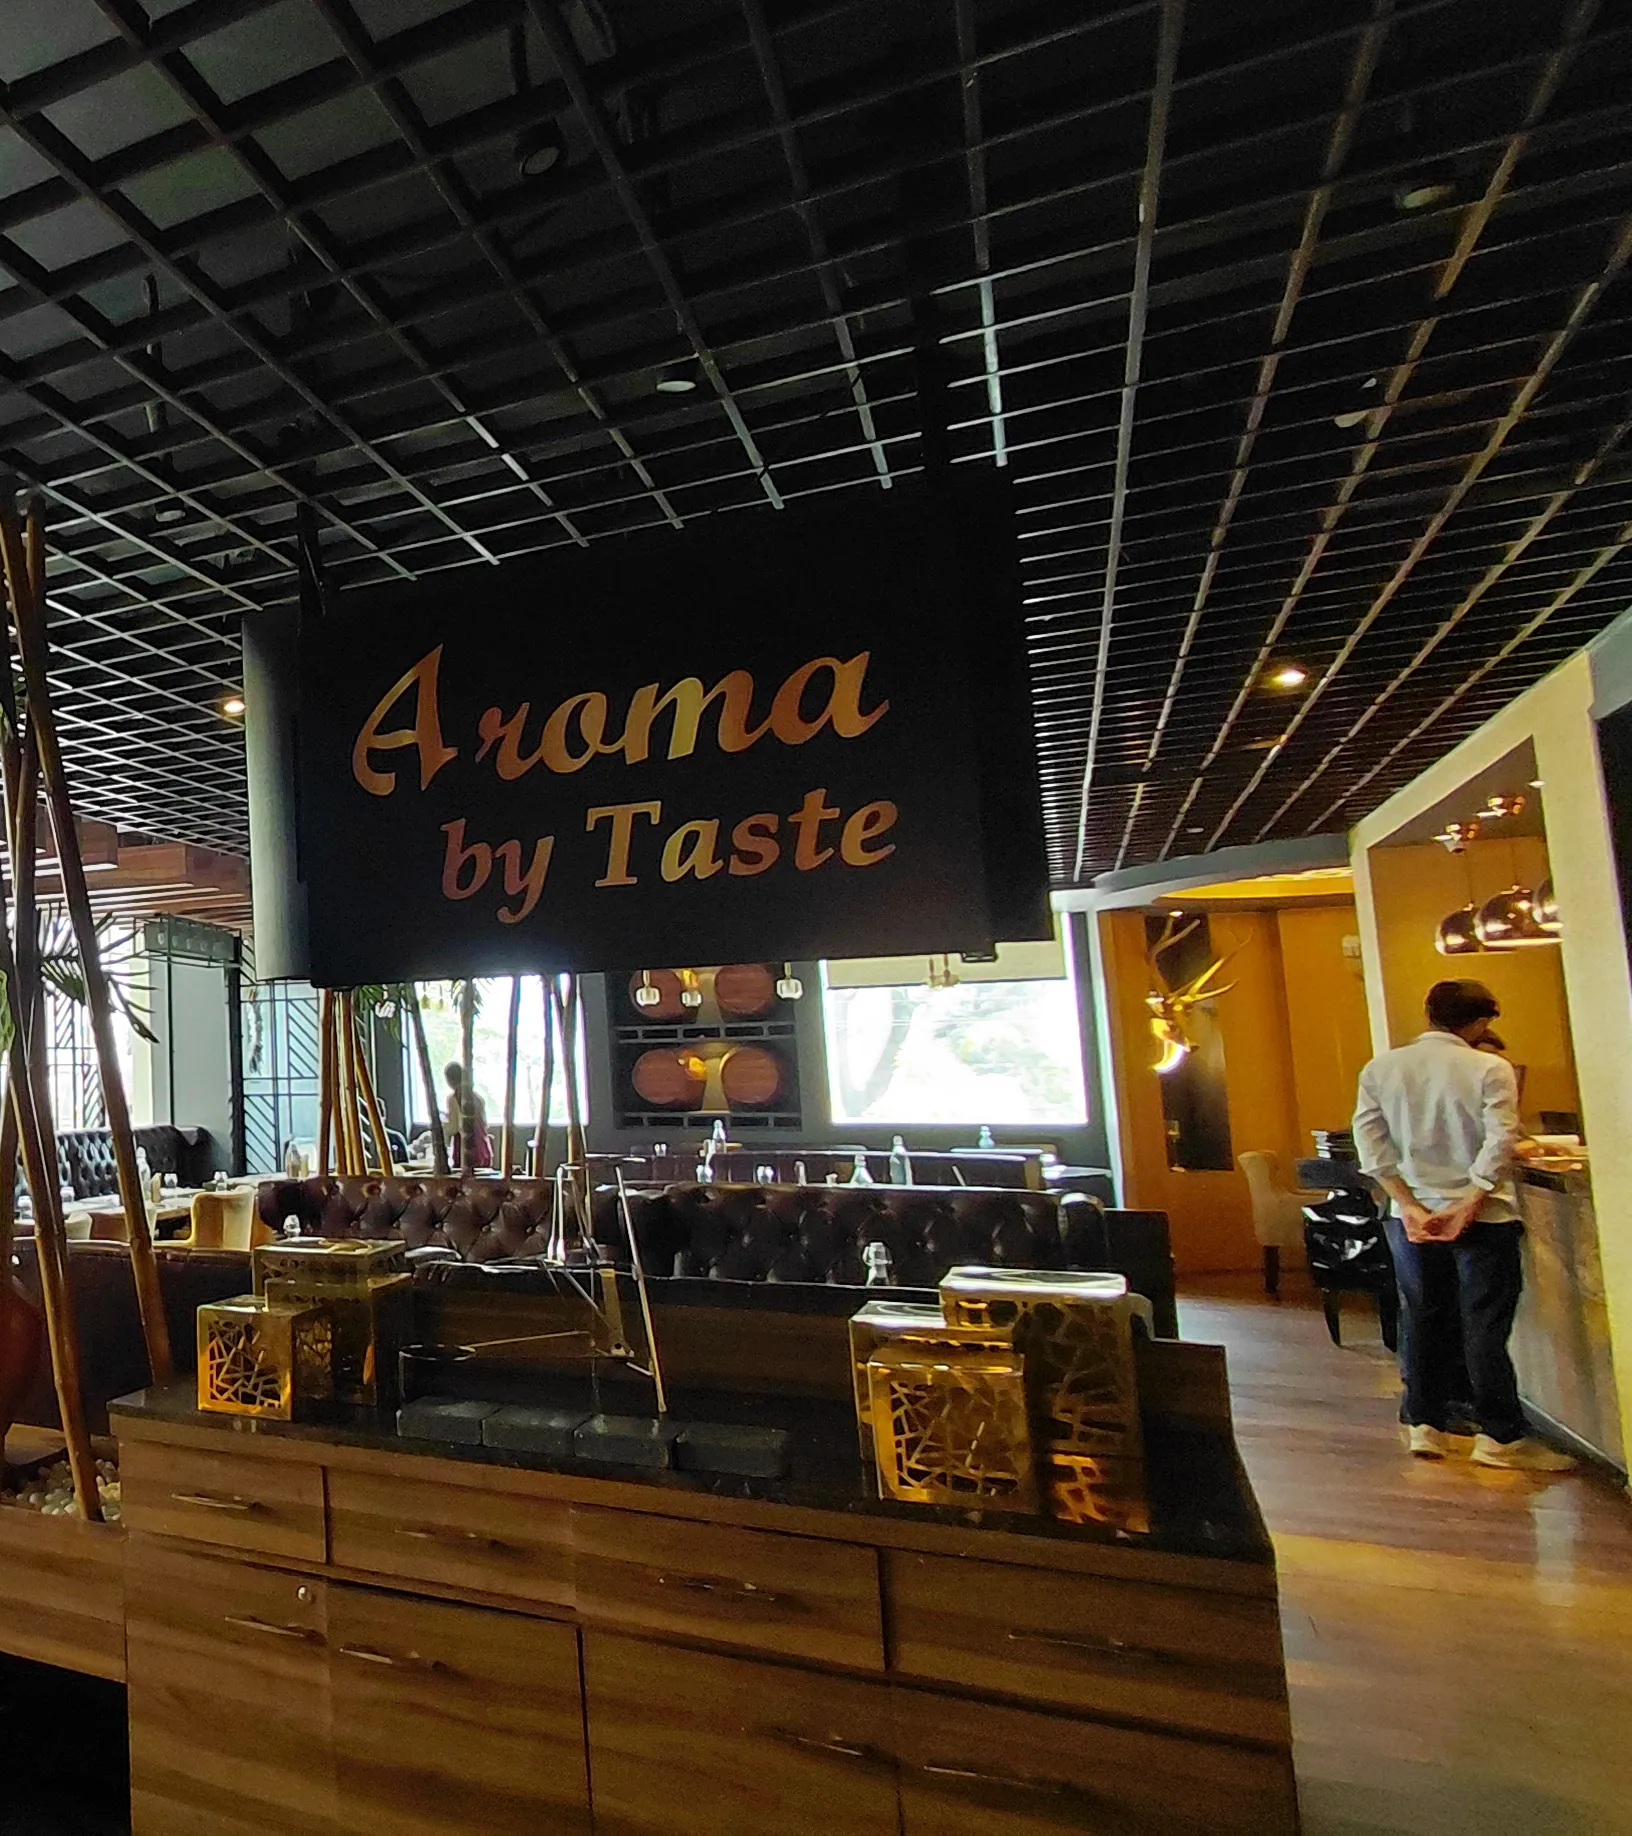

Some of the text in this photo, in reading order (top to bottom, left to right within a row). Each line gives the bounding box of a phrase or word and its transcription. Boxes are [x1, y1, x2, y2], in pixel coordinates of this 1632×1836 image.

[351, 643, 889, 796] Aroma
[440, 788, 899, 923] by Taste
